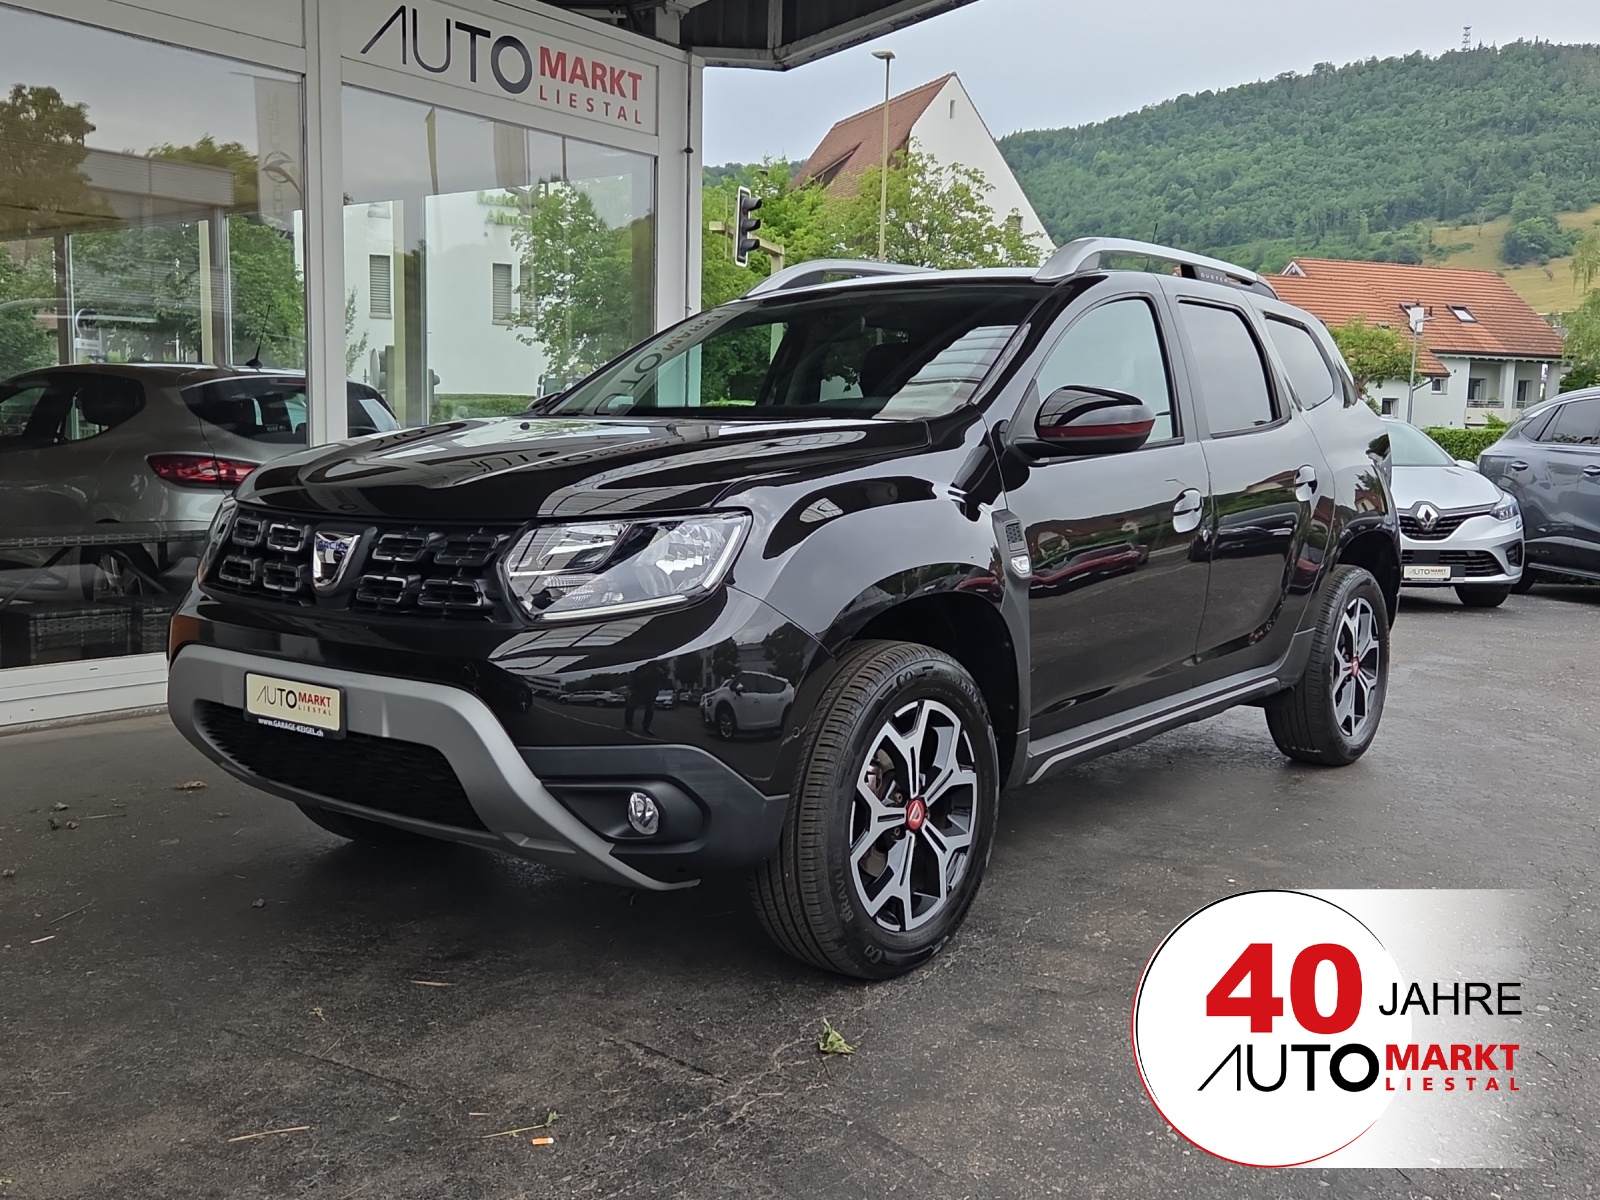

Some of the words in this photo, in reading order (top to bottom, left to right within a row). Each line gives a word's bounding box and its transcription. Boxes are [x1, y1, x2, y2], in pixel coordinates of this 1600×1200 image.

[360, 5, 533, 94] AUTO
[539, 46, 643, 101] MARKT
[539, 85, 642, 125] LIESTAL
[477, 190, 519, 207] Resid
[257, 685, 297, 708] AUTO
[297, 691, 331, 708] MARKT
[297, 704, 332, 716] LIESTAL
